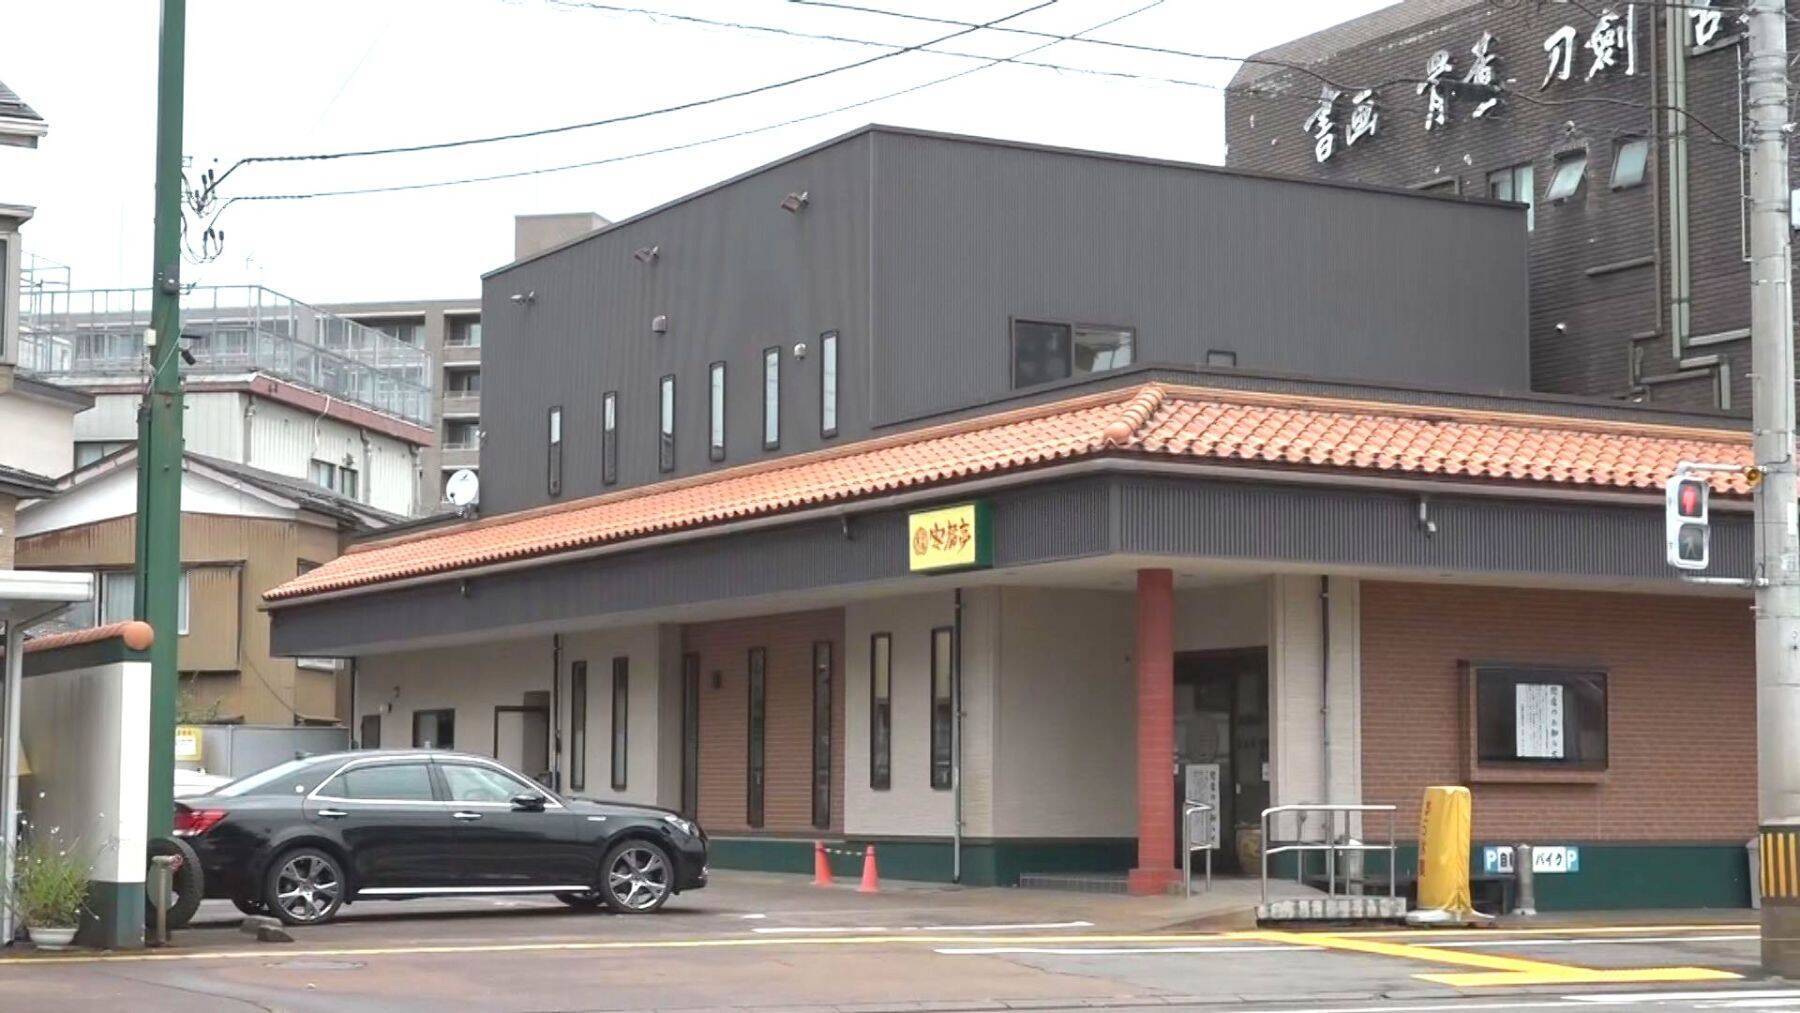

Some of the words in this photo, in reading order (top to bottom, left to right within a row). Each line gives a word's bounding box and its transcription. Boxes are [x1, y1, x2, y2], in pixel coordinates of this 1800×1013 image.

[1303, 86, 1379, 163] 書画
[1535, 853, 1563, 866] バイク
